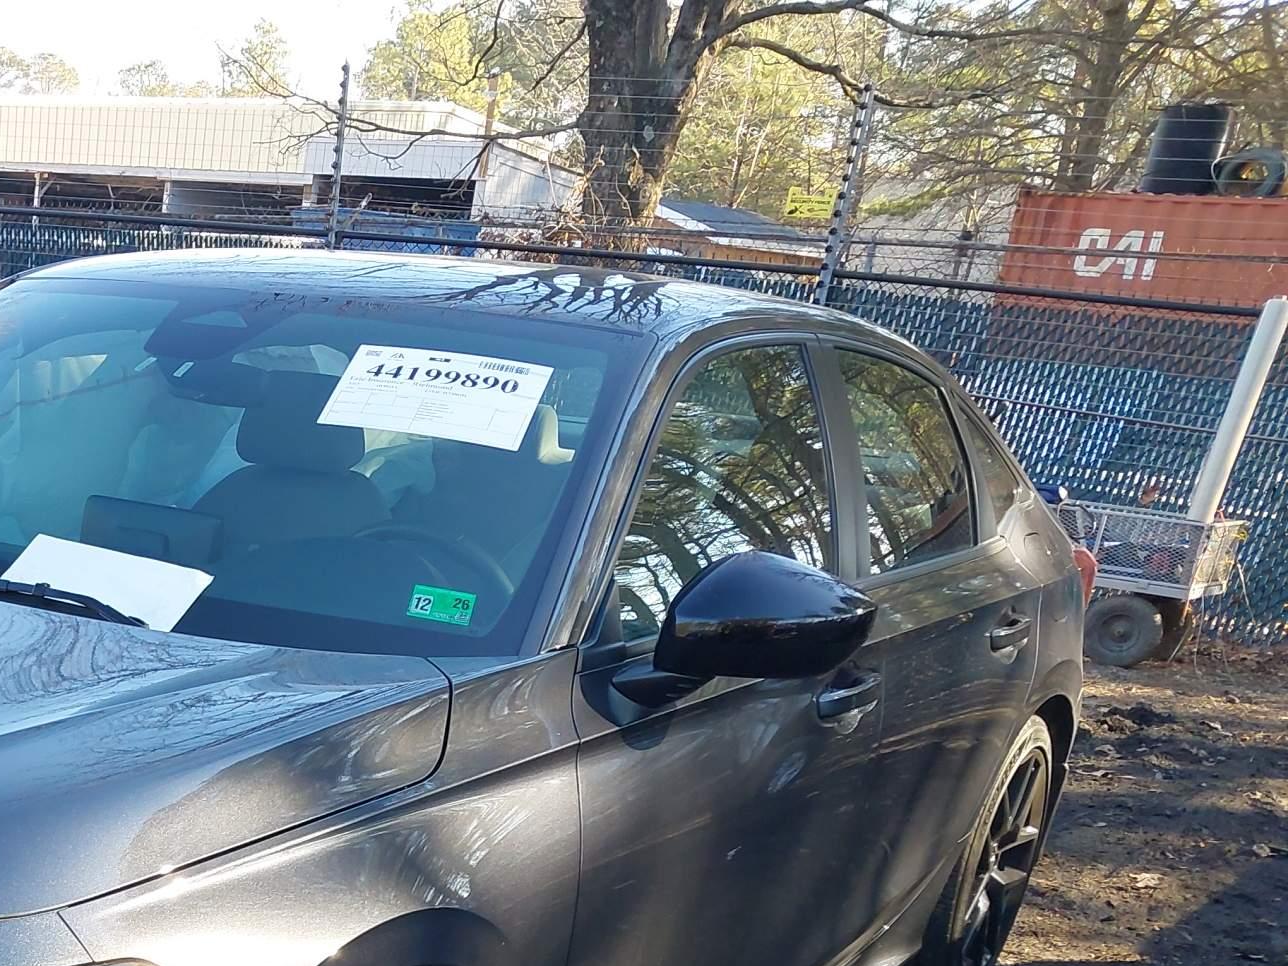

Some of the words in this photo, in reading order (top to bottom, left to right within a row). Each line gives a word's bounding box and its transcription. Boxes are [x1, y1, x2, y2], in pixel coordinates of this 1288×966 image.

[1073, 227, 1165, 280] CAI
[366, 363, 520, 394] 44199890
[414, 596, 432, 612] 12
[453, 597, 470, 610] 26
